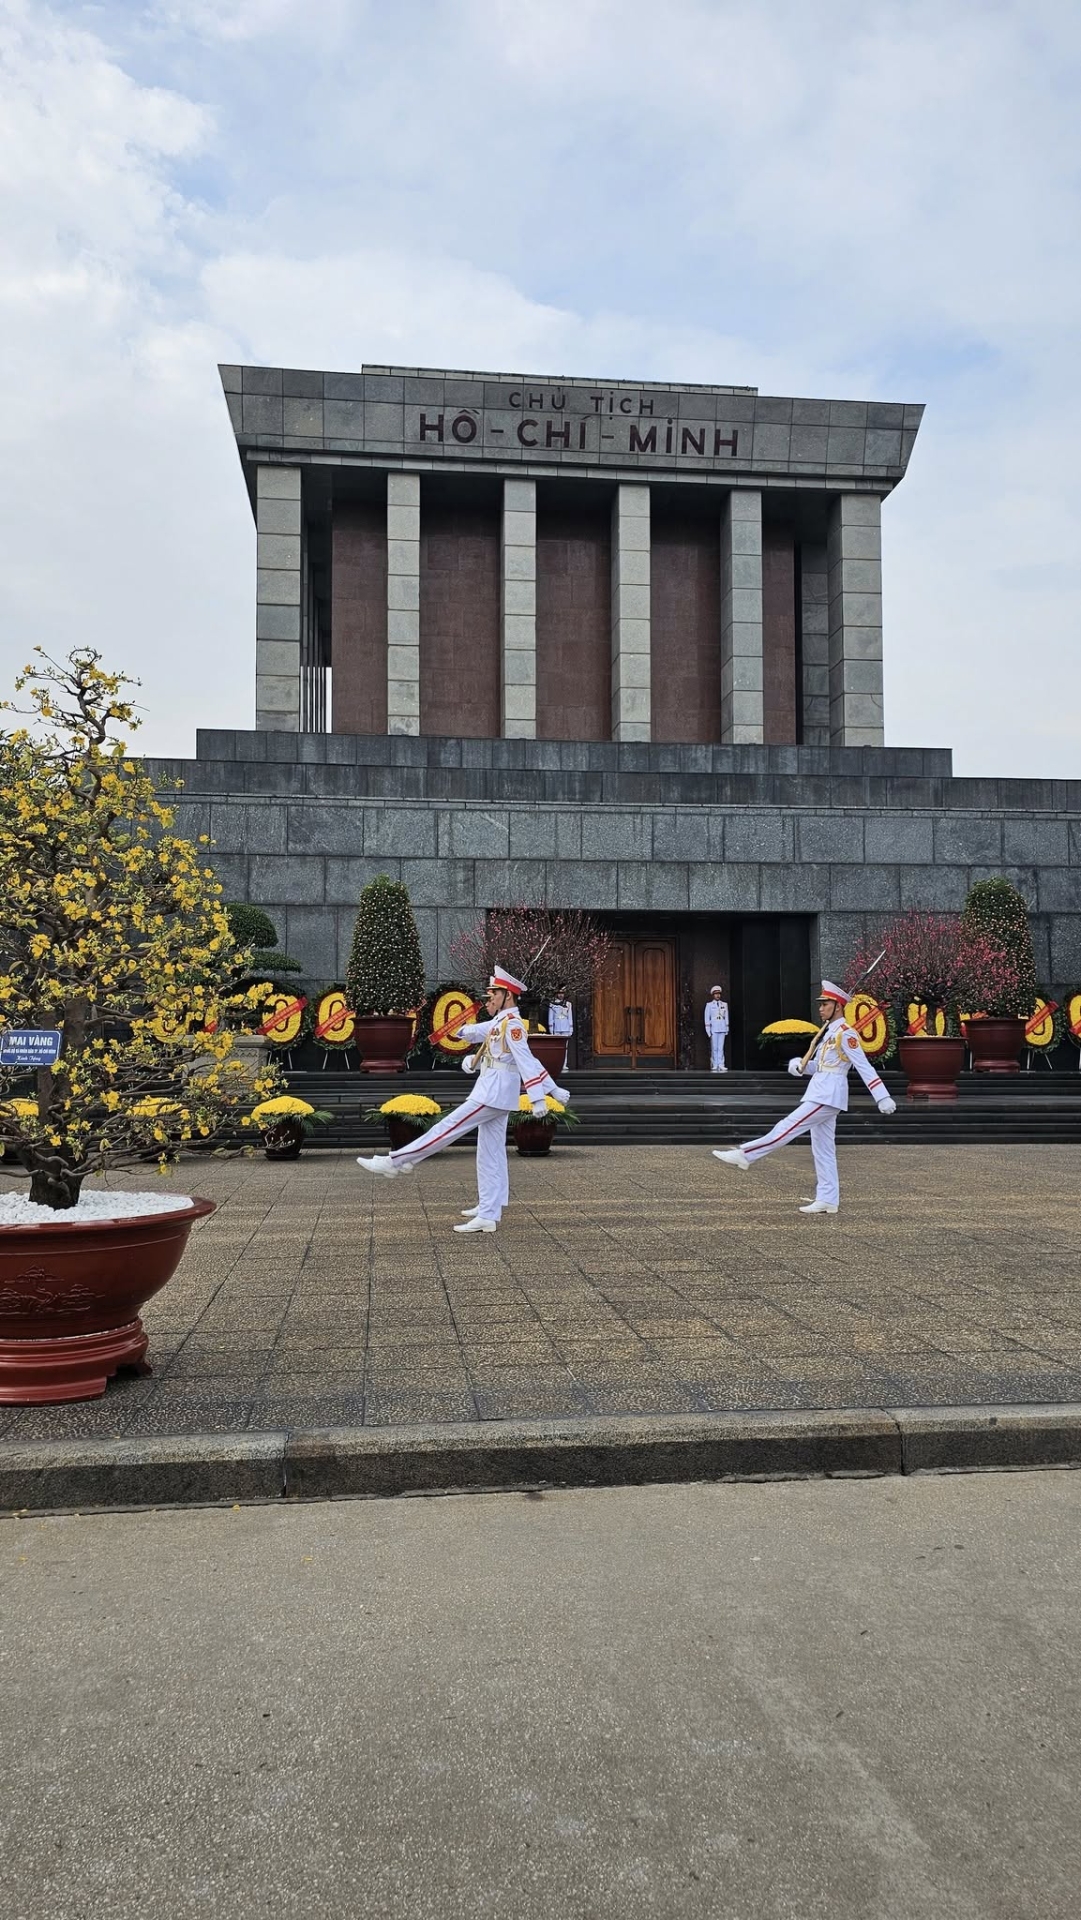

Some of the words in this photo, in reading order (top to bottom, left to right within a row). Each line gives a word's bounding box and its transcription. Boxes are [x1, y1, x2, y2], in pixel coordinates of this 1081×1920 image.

[419, 409, 480, 444] HỒ
[517, 415, 591, 450] CHÍ
[629, 418, 739, 457] MINH
[9, 1036, 26, 1046] MAI
[29, 1035, 53, 1046] VÀNG
